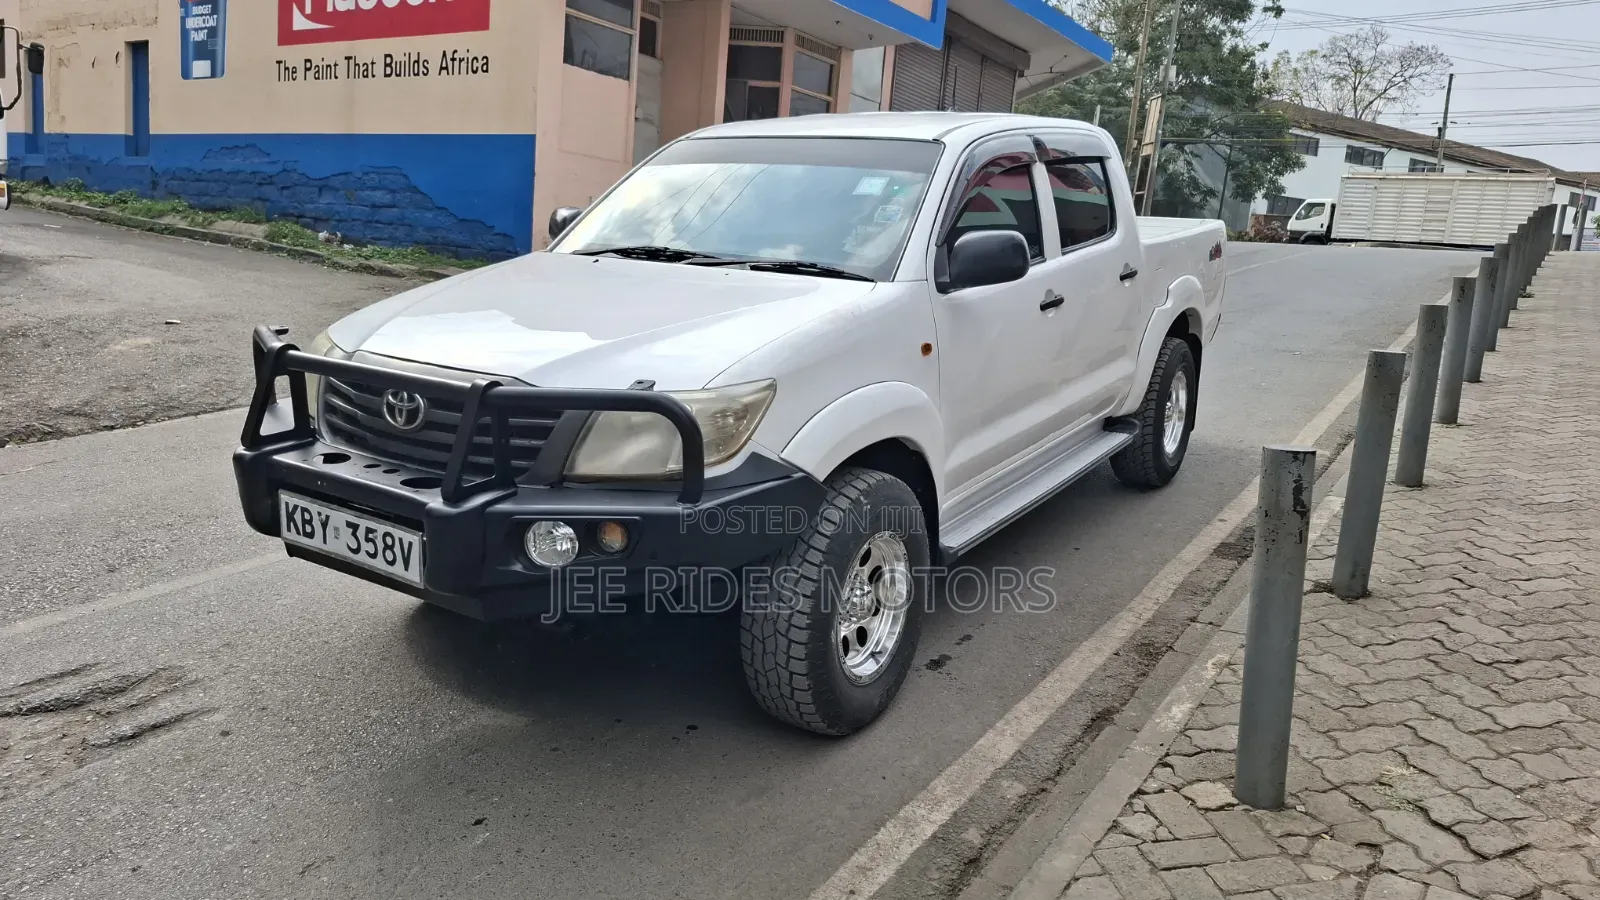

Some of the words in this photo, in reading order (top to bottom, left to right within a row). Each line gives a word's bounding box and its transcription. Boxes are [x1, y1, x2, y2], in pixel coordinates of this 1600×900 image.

[192, 4, 212, 15] BUDGET
[185, 15, 217, 29] UNDERCOAT
[190, 29, 208, 42] PAINT
[276, 60, 298, 82] The
[303, 57, 339, 81] Paint
[344, 55, 377, 79] That
[383, 52, 430, 78] Builds
[438, 49, 490, 76] Africa
[284, 501, 331, 546] KBY
[345, 520, 414, 572] 358V
